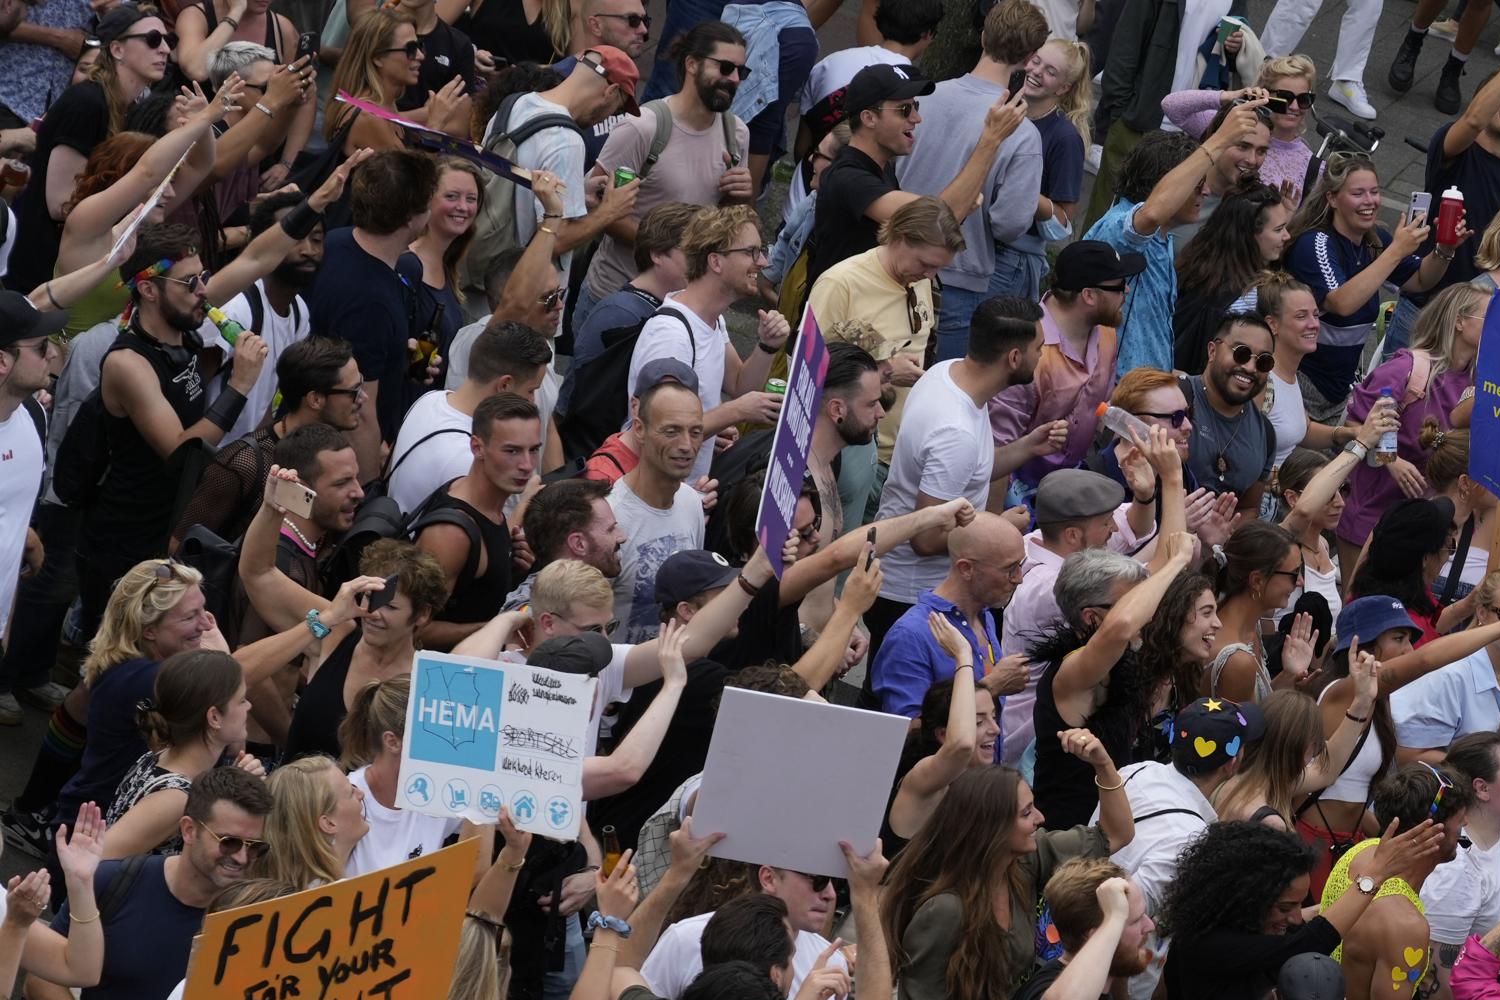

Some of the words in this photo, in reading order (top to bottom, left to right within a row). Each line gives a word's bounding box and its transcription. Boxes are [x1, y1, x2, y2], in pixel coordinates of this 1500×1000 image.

[803, 377, 816, 420] ALL
[796, 412, 811, 459] LOVE
[418, 696, 495, 734] HEMA
[213, 866, 436, 986] FIGHT
